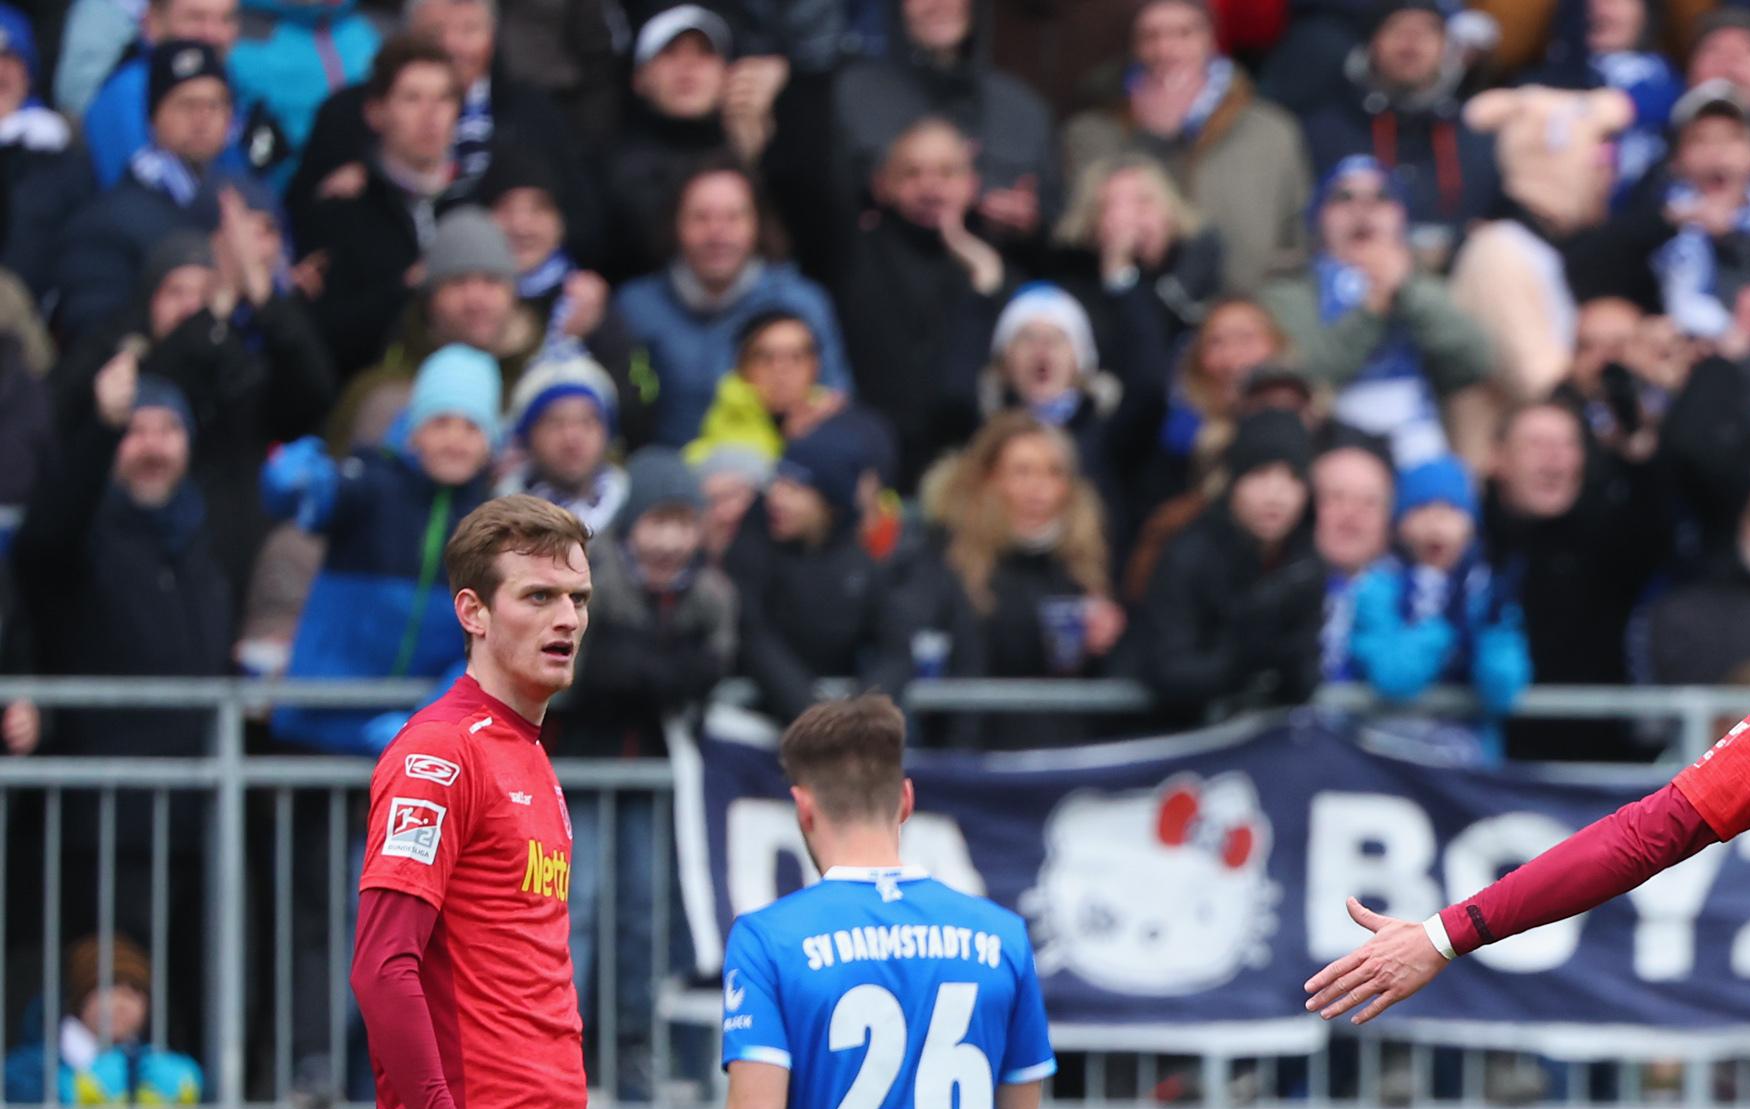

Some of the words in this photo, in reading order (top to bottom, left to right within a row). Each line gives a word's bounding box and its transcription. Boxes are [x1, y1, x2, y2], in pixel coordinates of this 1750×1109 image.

[802, 933, 834, 971] SV
[834, 925, 972, 962] DARMSTADT
[974, 932, 1001, 969] 98
